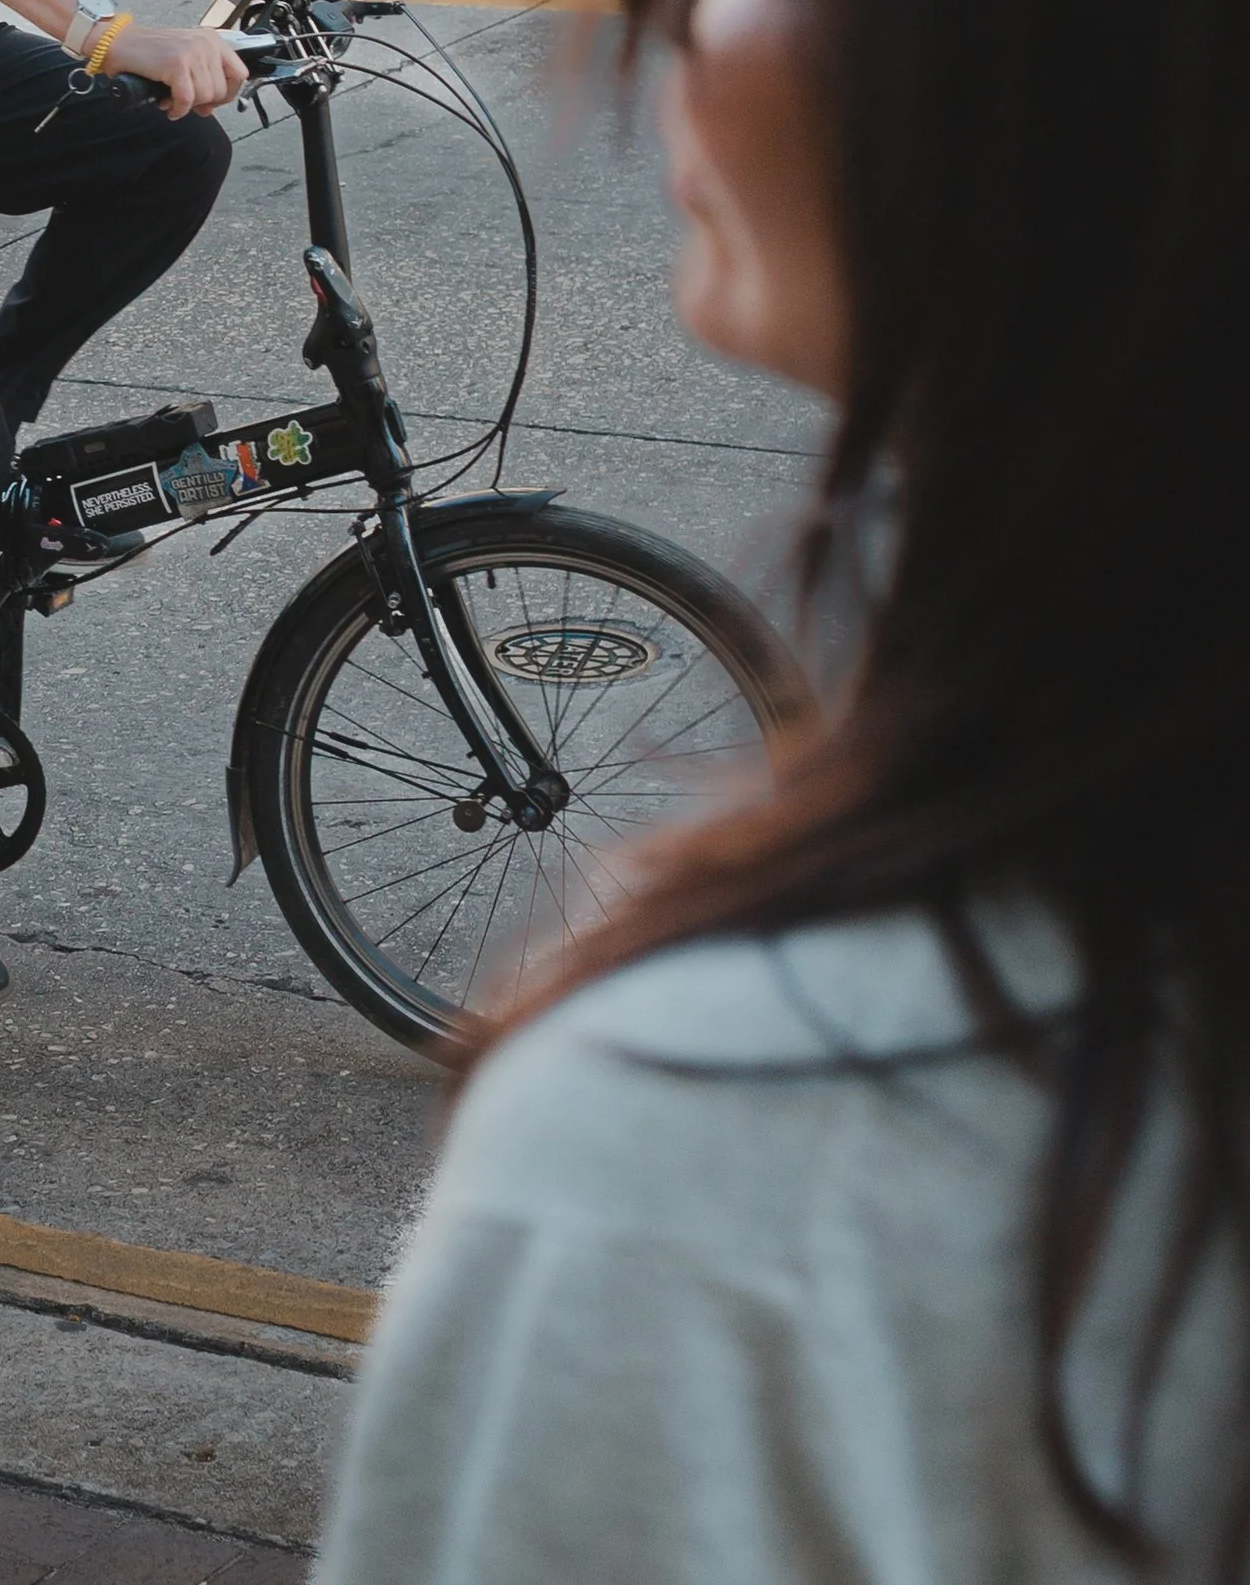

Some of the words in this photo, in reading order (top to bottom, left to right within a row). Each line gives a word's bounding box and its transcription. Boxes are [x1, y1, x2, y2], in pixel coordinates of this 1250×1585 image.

[171, 471, 226, 490] GENTILLY
[81, 481, 154, 510] NEVERTHELESS,
[85, 504, 105, 518] SHE
[104, 491, 157, 513] PERSISTED.
[178, 482, 226, 504] ARTIST
